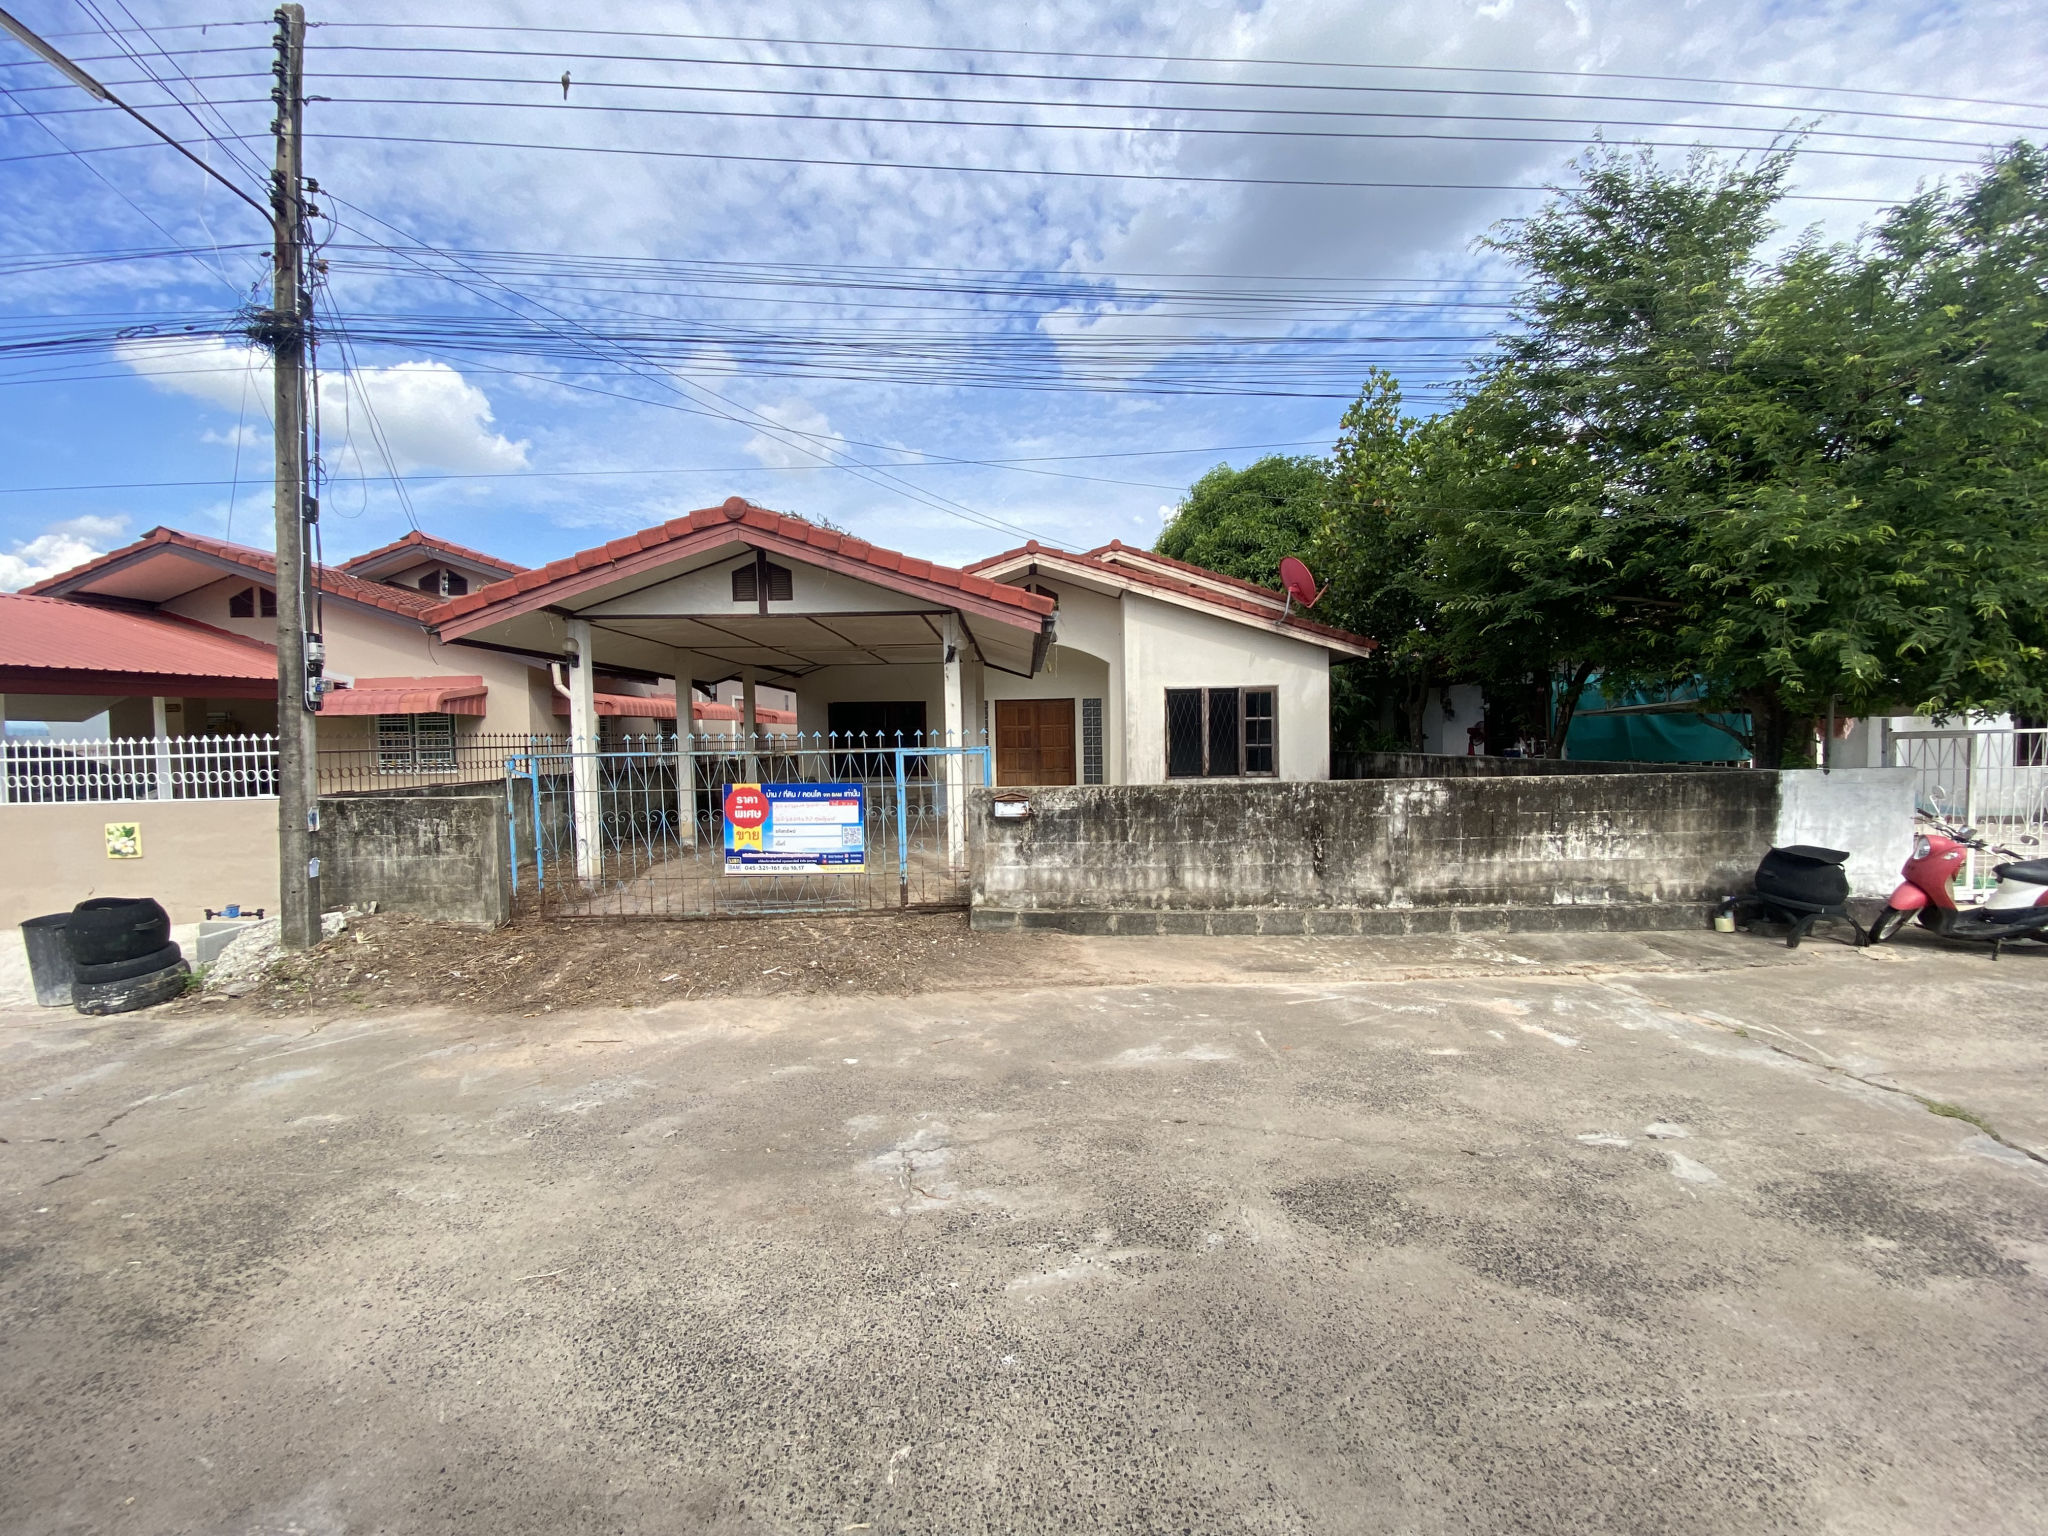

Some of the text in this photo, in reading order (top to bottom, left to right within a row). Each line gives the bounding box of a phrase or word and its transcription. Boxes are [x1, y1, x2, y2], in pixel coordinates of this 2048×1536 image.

[766, 790, 777, 798] บ้าน
[783, 789, 796, 798] ที่ดิน
[802, 790, 821, 798] คอนโด
[736, 796, 758, 804] ราคา
[734, 806, 762, 818] พิเศษ
[736, 830, 760, 841] ขาย
